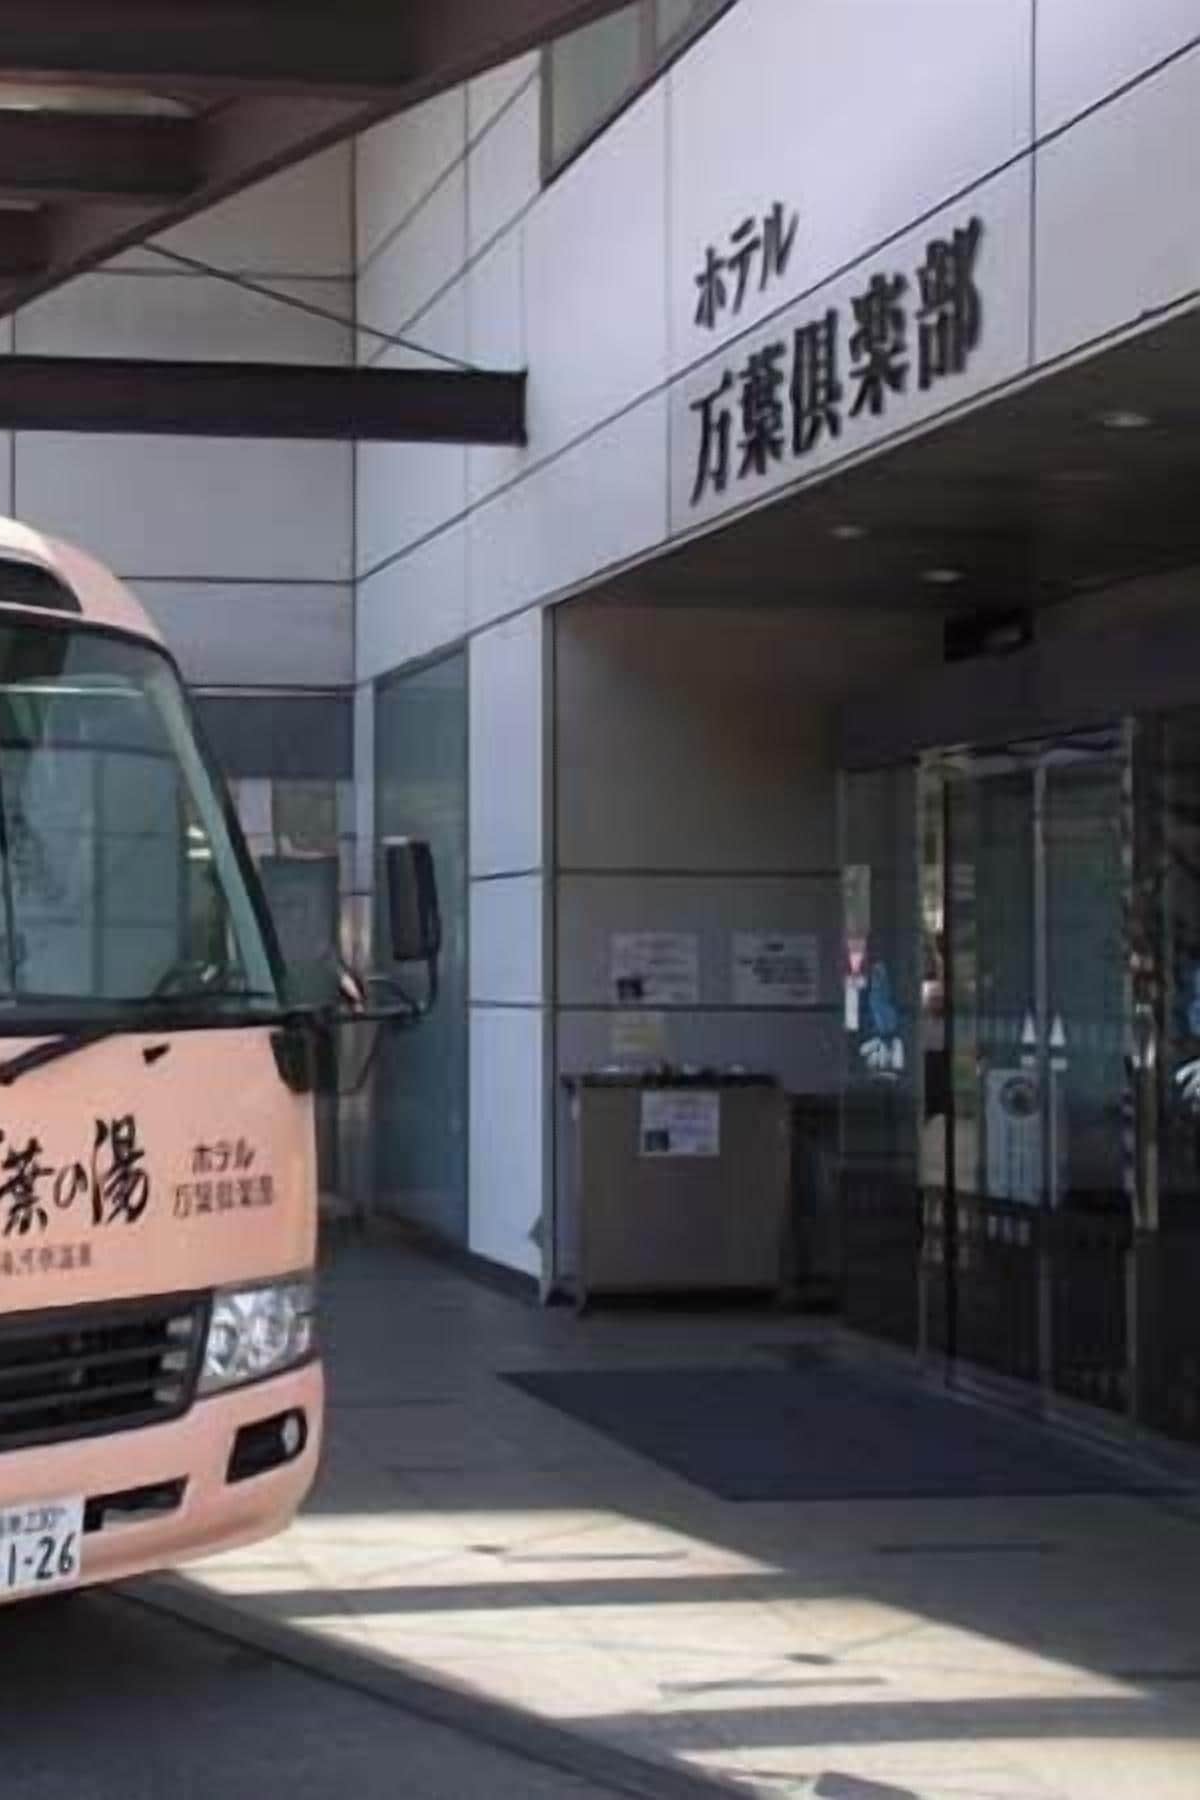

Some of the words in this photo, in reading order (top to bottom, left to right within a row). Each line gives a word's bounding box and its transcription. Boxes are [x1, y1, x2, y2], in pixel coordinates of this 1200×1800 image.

[695, 201, 799, 330] ホテル
[688, 216, 983, 507] 万葉倶楽部
[191, 1137, 257, 1175] ホテル
